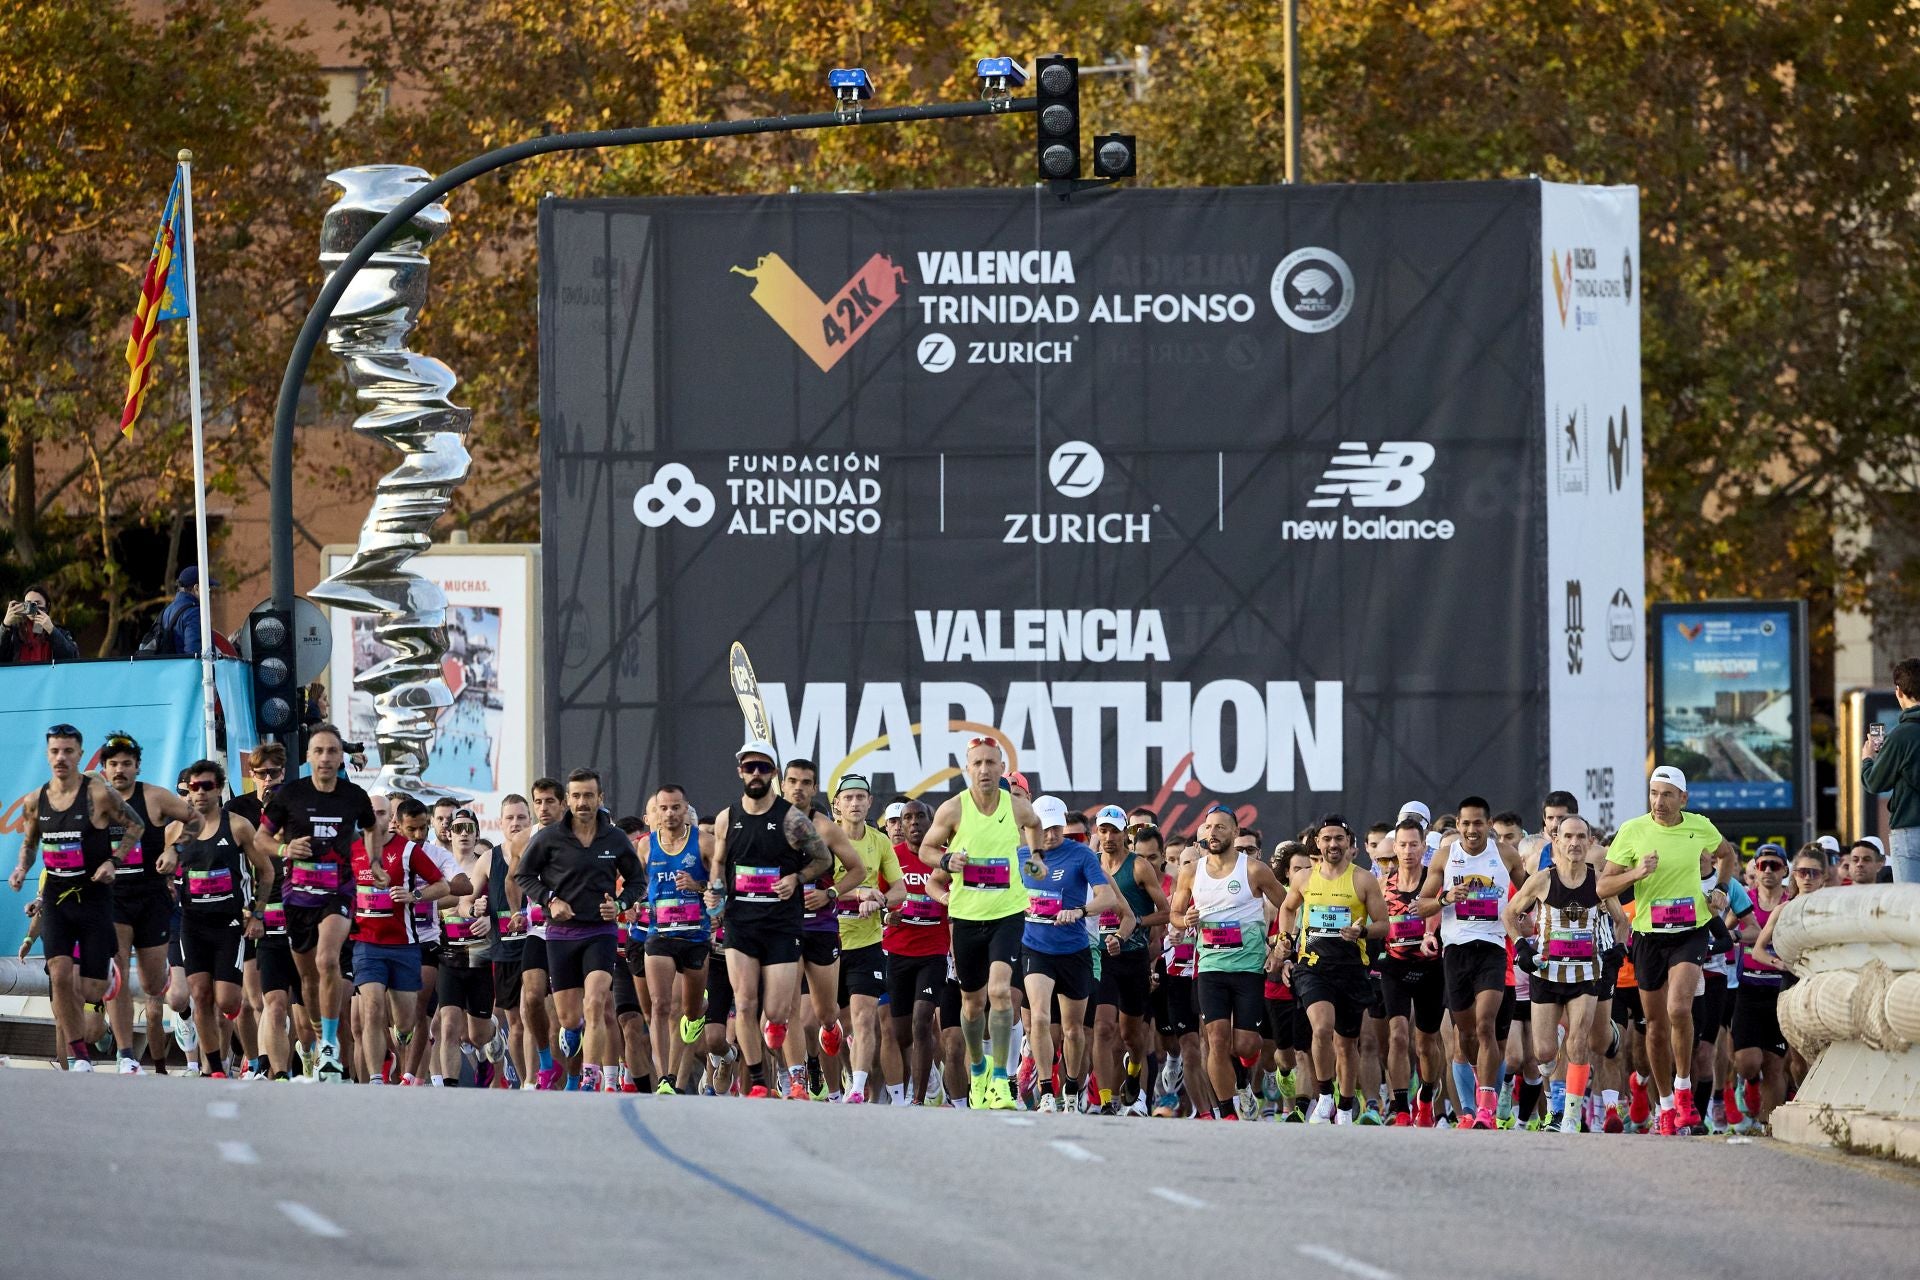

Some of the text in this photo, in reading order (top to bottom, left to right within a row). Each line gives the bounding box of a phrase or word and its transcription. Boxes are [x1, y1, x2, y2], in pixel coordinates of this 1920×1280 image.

[918, 251, 1075, 284] VALENCIA
[823, 277, 883, 347] 42K
[919, 294, 1256, 323] TRINIDAD ALFONSO
[967, 341, 1074, 364] ZURICH
[729, 453, 880, 473] FUNDACIÓN
[727, 479, 881, 505] TRINIDAD
[728, 508, 881, 535] ALFONSO
[1003, 514, 1151, 544] ZURICH
[1282, 515, 1455, 541] new balance
[444, 579, 490, 592] MUCHAS.
[915, 609, 1170, 662] VALENCIA
[744, 680, 1344, 794] MARATHON
[1320, 913, 1337, 921] 4598
